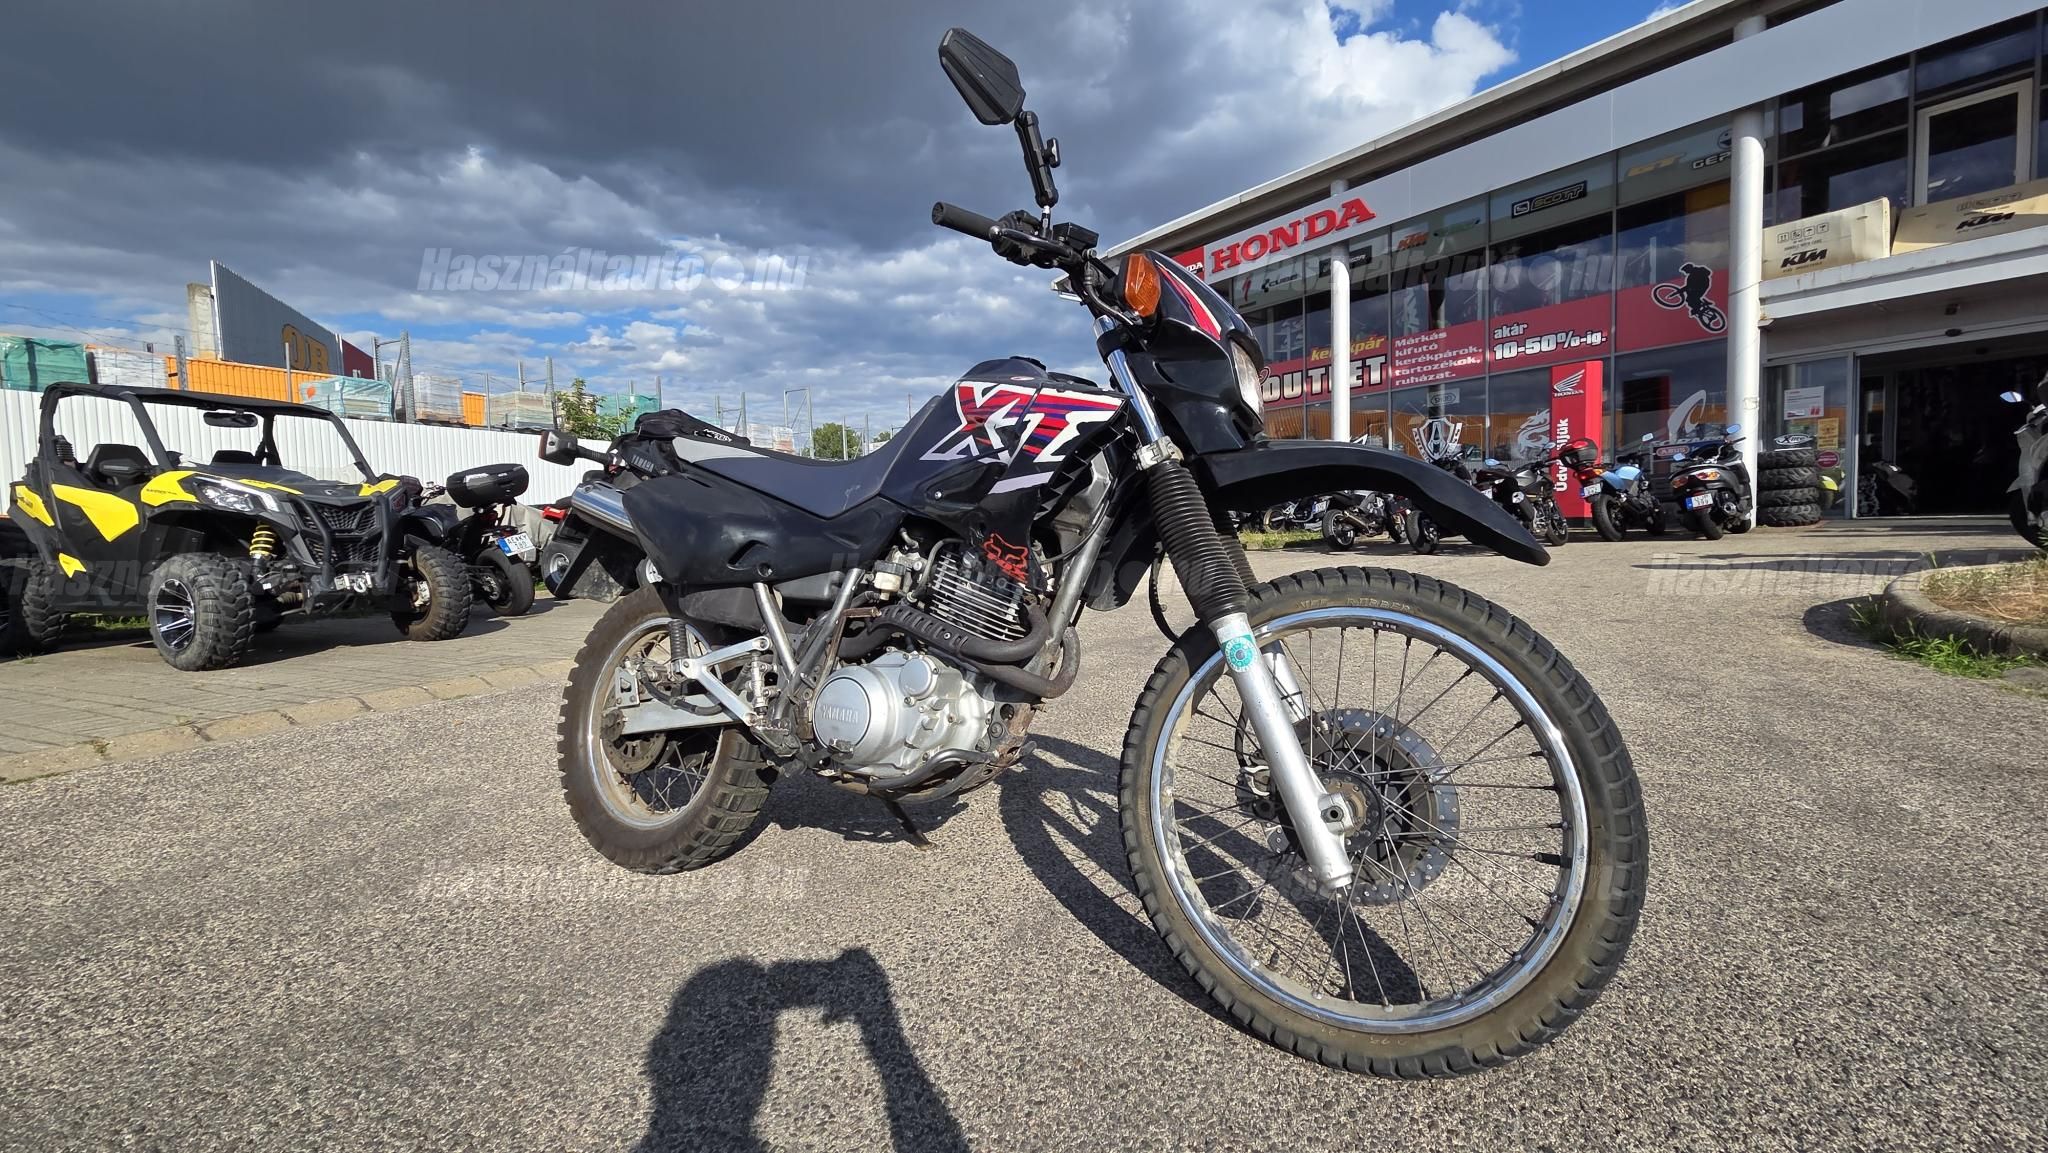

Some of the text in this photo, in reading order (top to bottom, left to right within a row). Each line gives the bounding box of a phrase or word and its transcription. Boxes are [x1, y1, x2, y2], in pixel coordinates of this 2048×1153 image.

[1956, 211, 2016, 230] KTM
[1211, 198, 1376, 273] HONDA
[1780, 248, 1828, 269] KTM
[1394, 331, 1448, 348] Márkás
[1494, 322, 1528, 340] akár
[1394, 342, 1438, 358] kifutó
[1493, 331, 1608, 361] 10-50%-ig.
[1263, 355, 1386, 403] OUTET
[1395, 371, 1457, 386] ruházat.
[1553, 389, 1585, 398] HONDA
[821, 703, 859, 725] YAMAHA
